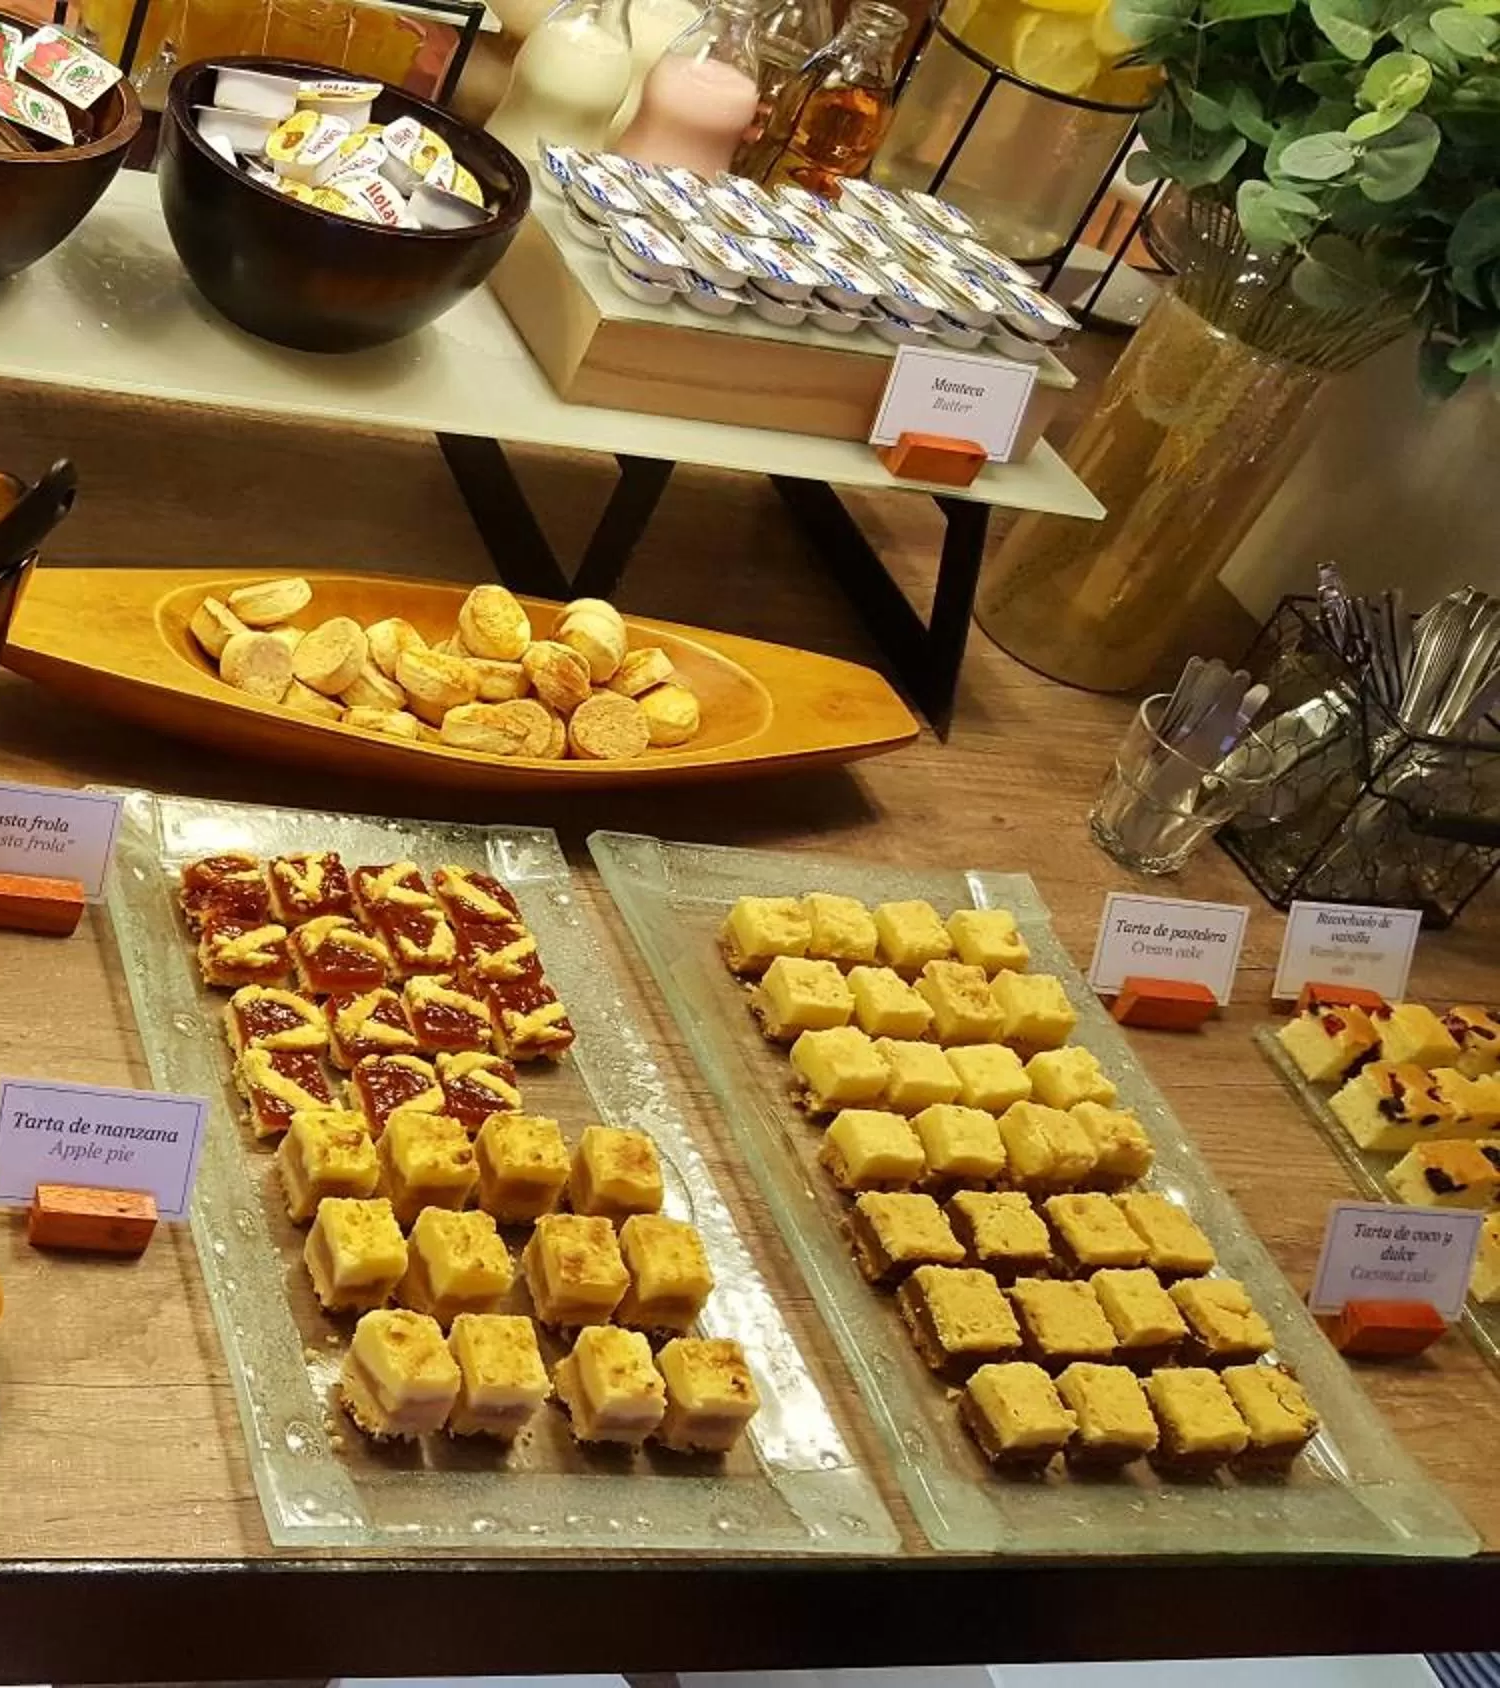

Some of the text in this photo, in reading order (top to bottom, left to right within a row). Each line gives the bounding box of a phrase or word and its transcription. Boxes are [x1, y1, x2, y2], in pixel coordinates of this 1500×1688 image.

[932, 377, 986, 398] Manteca
[932, 397, 973, 416] Butter
[26, 815, 69, 833] frola
[1115, 919, 1151, 936] Tarta
[1153, 923, 1170, 937] de
[14, 1111, 180, 1144] Tarta de manzana
[48, 1139, 135, 1165] Apple pie
[1353, 1223, 1454, 1246] Tarta de coco y
[1380, 1246, 1419, 1262] dulce
